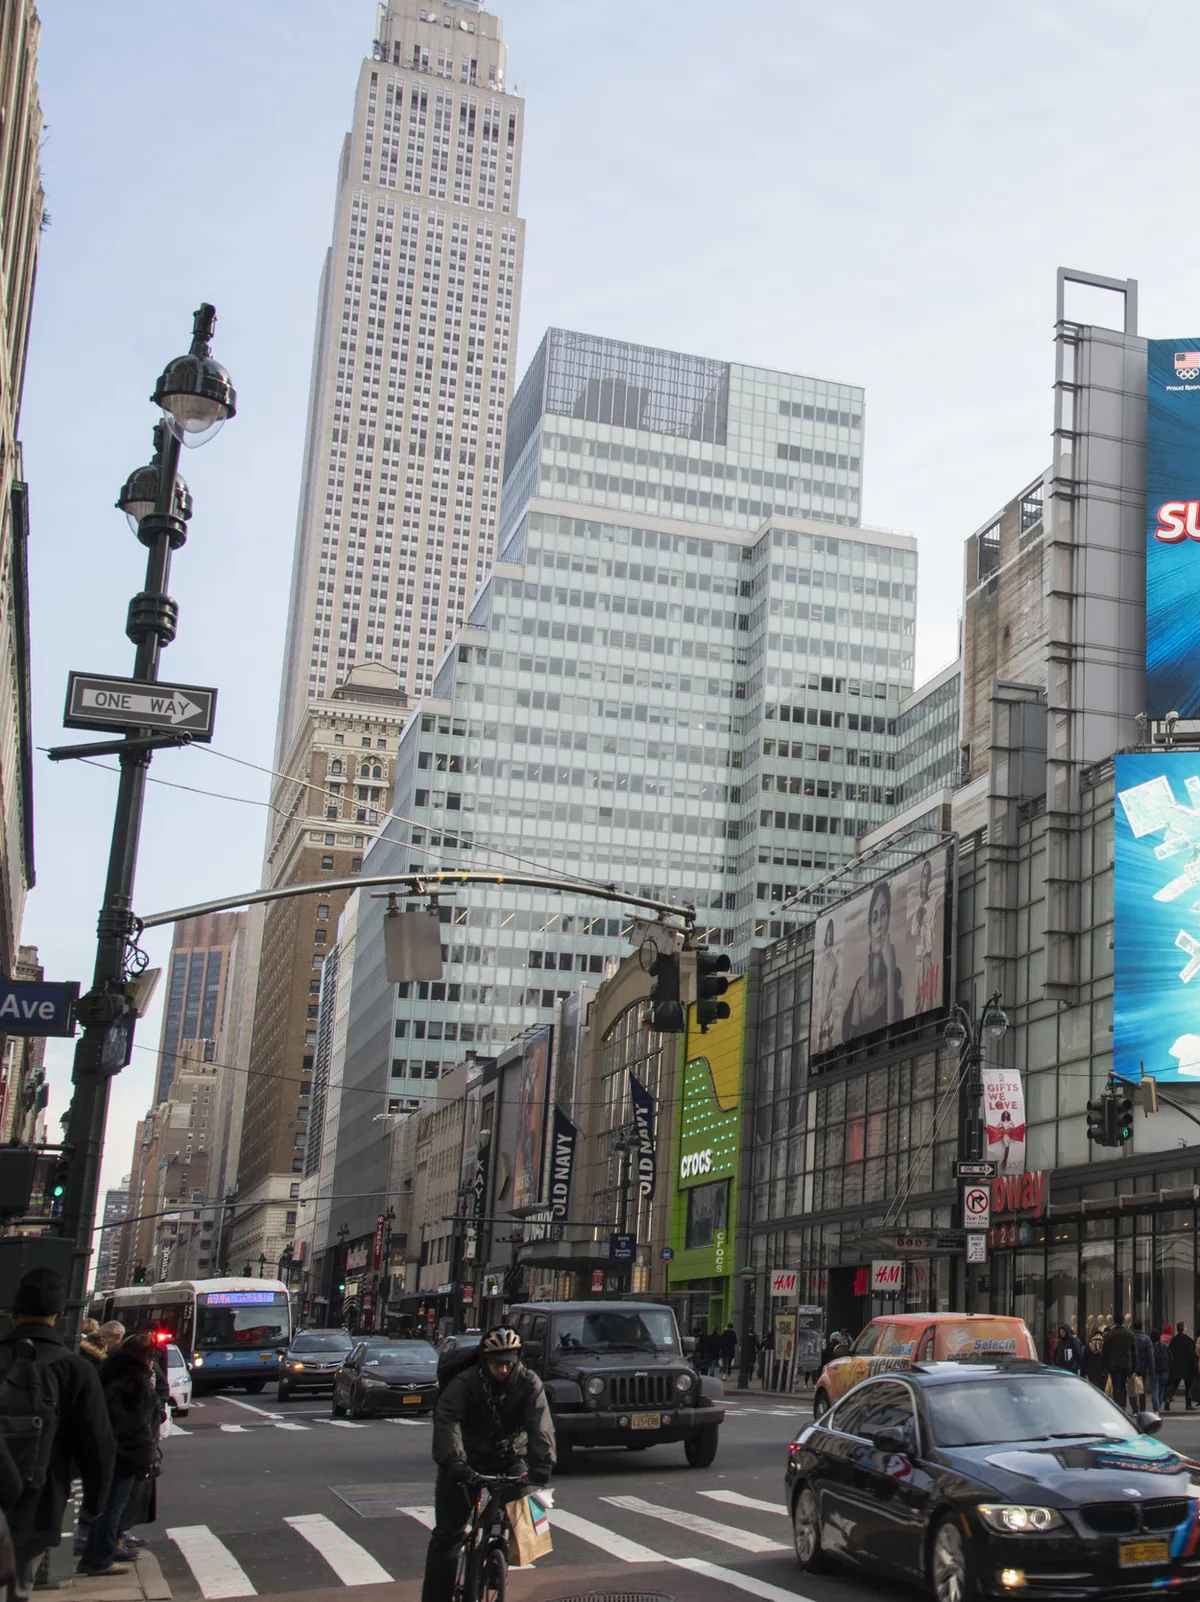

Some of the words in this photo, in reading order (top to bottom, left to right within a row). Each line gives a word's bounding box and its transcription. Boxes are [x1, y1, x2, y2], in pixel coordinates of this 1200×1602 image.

[95, 692, 131, 709] ONE
[150, 698, 190, 715] WAY
[0, 993, 55, 1021] Ave
[987, 1083, 1019, 1092] GIFTS
[988, 1093, 1006, 1101] WE
[989, 1100, 1019, 1111] LOVE
[635, 1102, 653, 1155] NAVY
[554, 1131, 573, 1180] NAVY
[681, 1148, 714, 1179] crocs
[474, 1159, 485, 1200] KAY
[639, 1157, 654, 1196] OLD
[552, 1183, 568, 1217] OLD
[161, 1246, 170, 1279] wework
[716, 1231, 728, 1273] crocs
[773, 1274, 796, 1290] H&M
[875, 1265, 901, 1284] H&M
